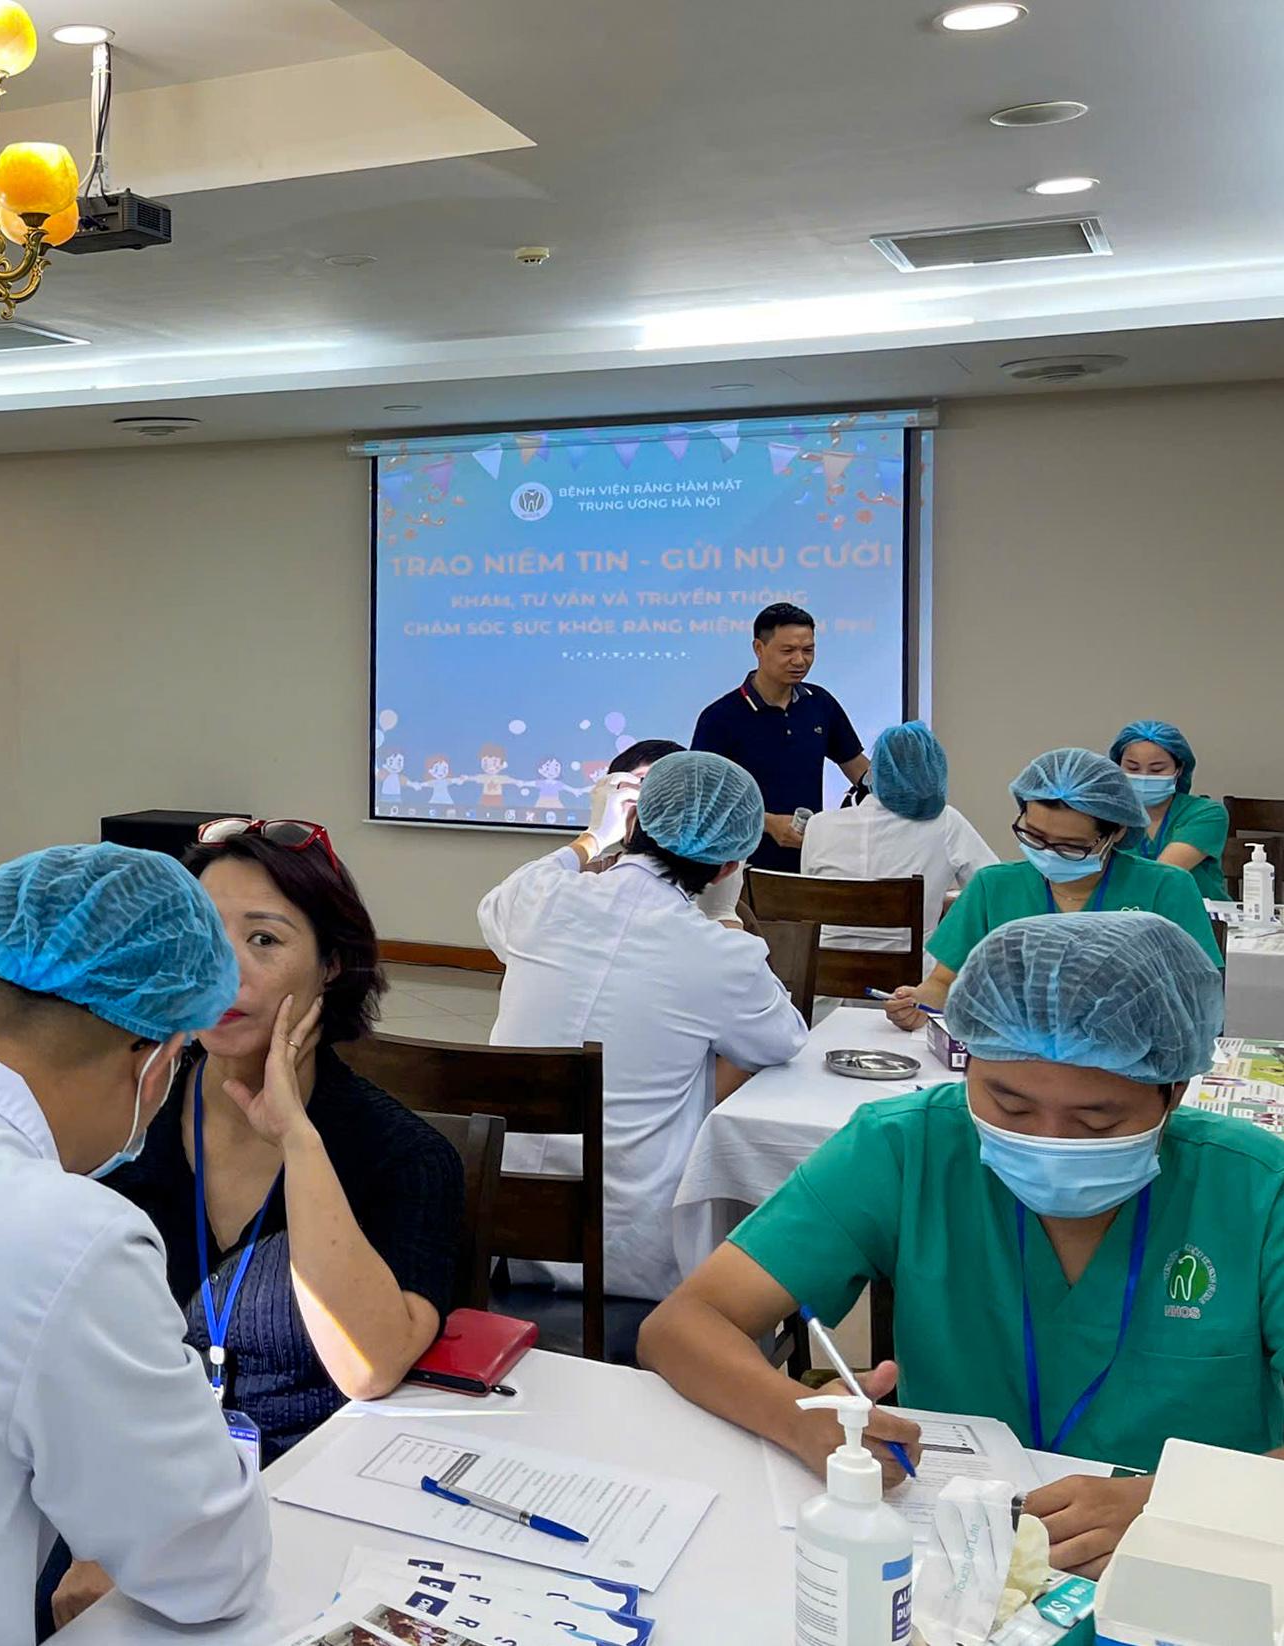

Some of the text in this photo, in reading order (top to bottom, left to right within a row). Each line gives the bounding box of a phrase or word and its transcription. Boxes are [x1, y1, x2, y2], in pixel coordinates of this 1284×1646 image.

[559, 484, 596, 498] BỆNH
[600, 482, 630, 497] VIỆN
[676, 478, 708, 493] HÀM
[712, 477, 743, 494] MẶT
[578, 500, 624, 512] TRUNG
[671, 496, 692, 508] HÀ
[695, 494, 721, 509] NỘI
[391, 554, 474, 576] TRAO
[576, 550, 629, 572] TIN
[735, 546, 785, 573] NỤ
[689, 616, 753, 635] MIỆN
